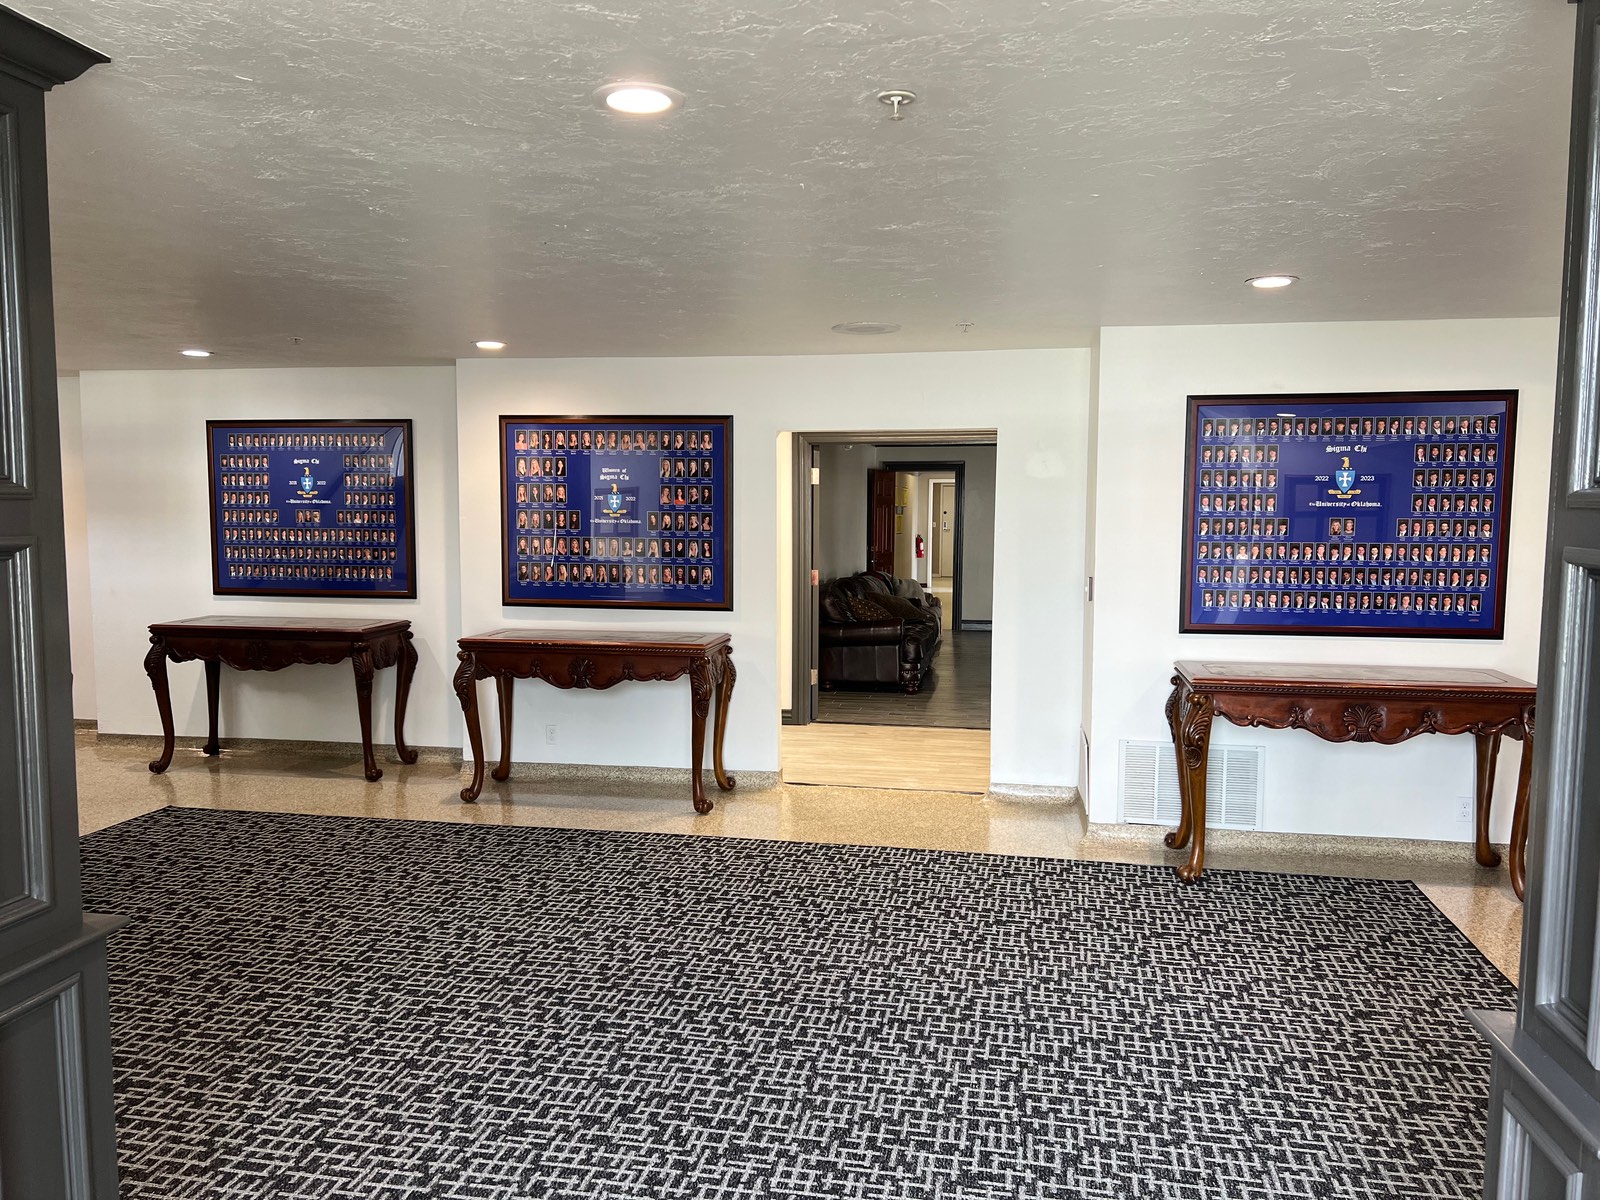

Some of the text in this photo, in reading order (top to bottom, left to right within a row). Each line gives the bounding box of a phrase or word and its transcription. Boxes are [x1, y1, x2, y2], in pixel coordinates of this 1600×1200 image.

[1325, 444, 1368, 453] Sigma Chi
[1315, 500, 1347, 508] University
